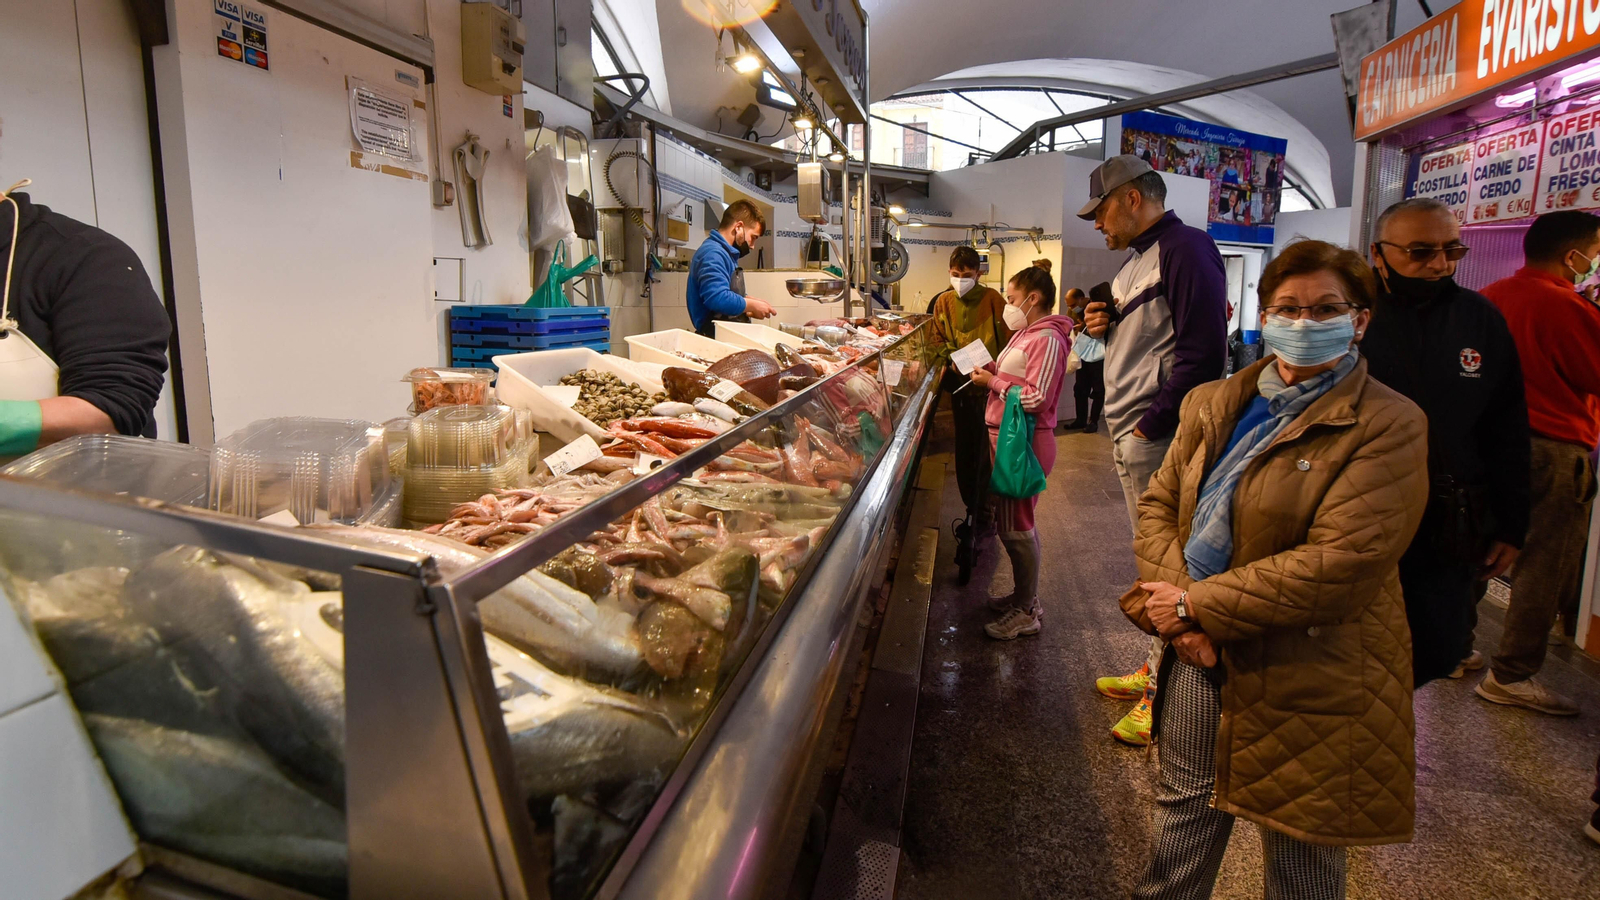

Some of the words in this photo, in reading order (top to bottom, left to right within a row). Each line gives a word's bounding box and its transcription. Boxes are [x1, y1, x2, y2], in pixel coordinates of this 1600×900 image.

[218, 0, 239, 14] VISA
[245, 10, 265, 24] VISA
[1363, 13, 1458, 127] CARNICERIA
[1477, 128, 1538, 158] OFERTA
[1549, 131, 1595, 157] CINTA
[1421, 148, 1471, 173] OFERTA
[1474, 159, 1513, 181] CARNE
[1517, 153, 1536, 173] DE
[1418, 172, 1468, 194] COSTILLA
[1480, 178, 1522, 199] CERDO
[1507, 198, 1530, 213] €/Kg
